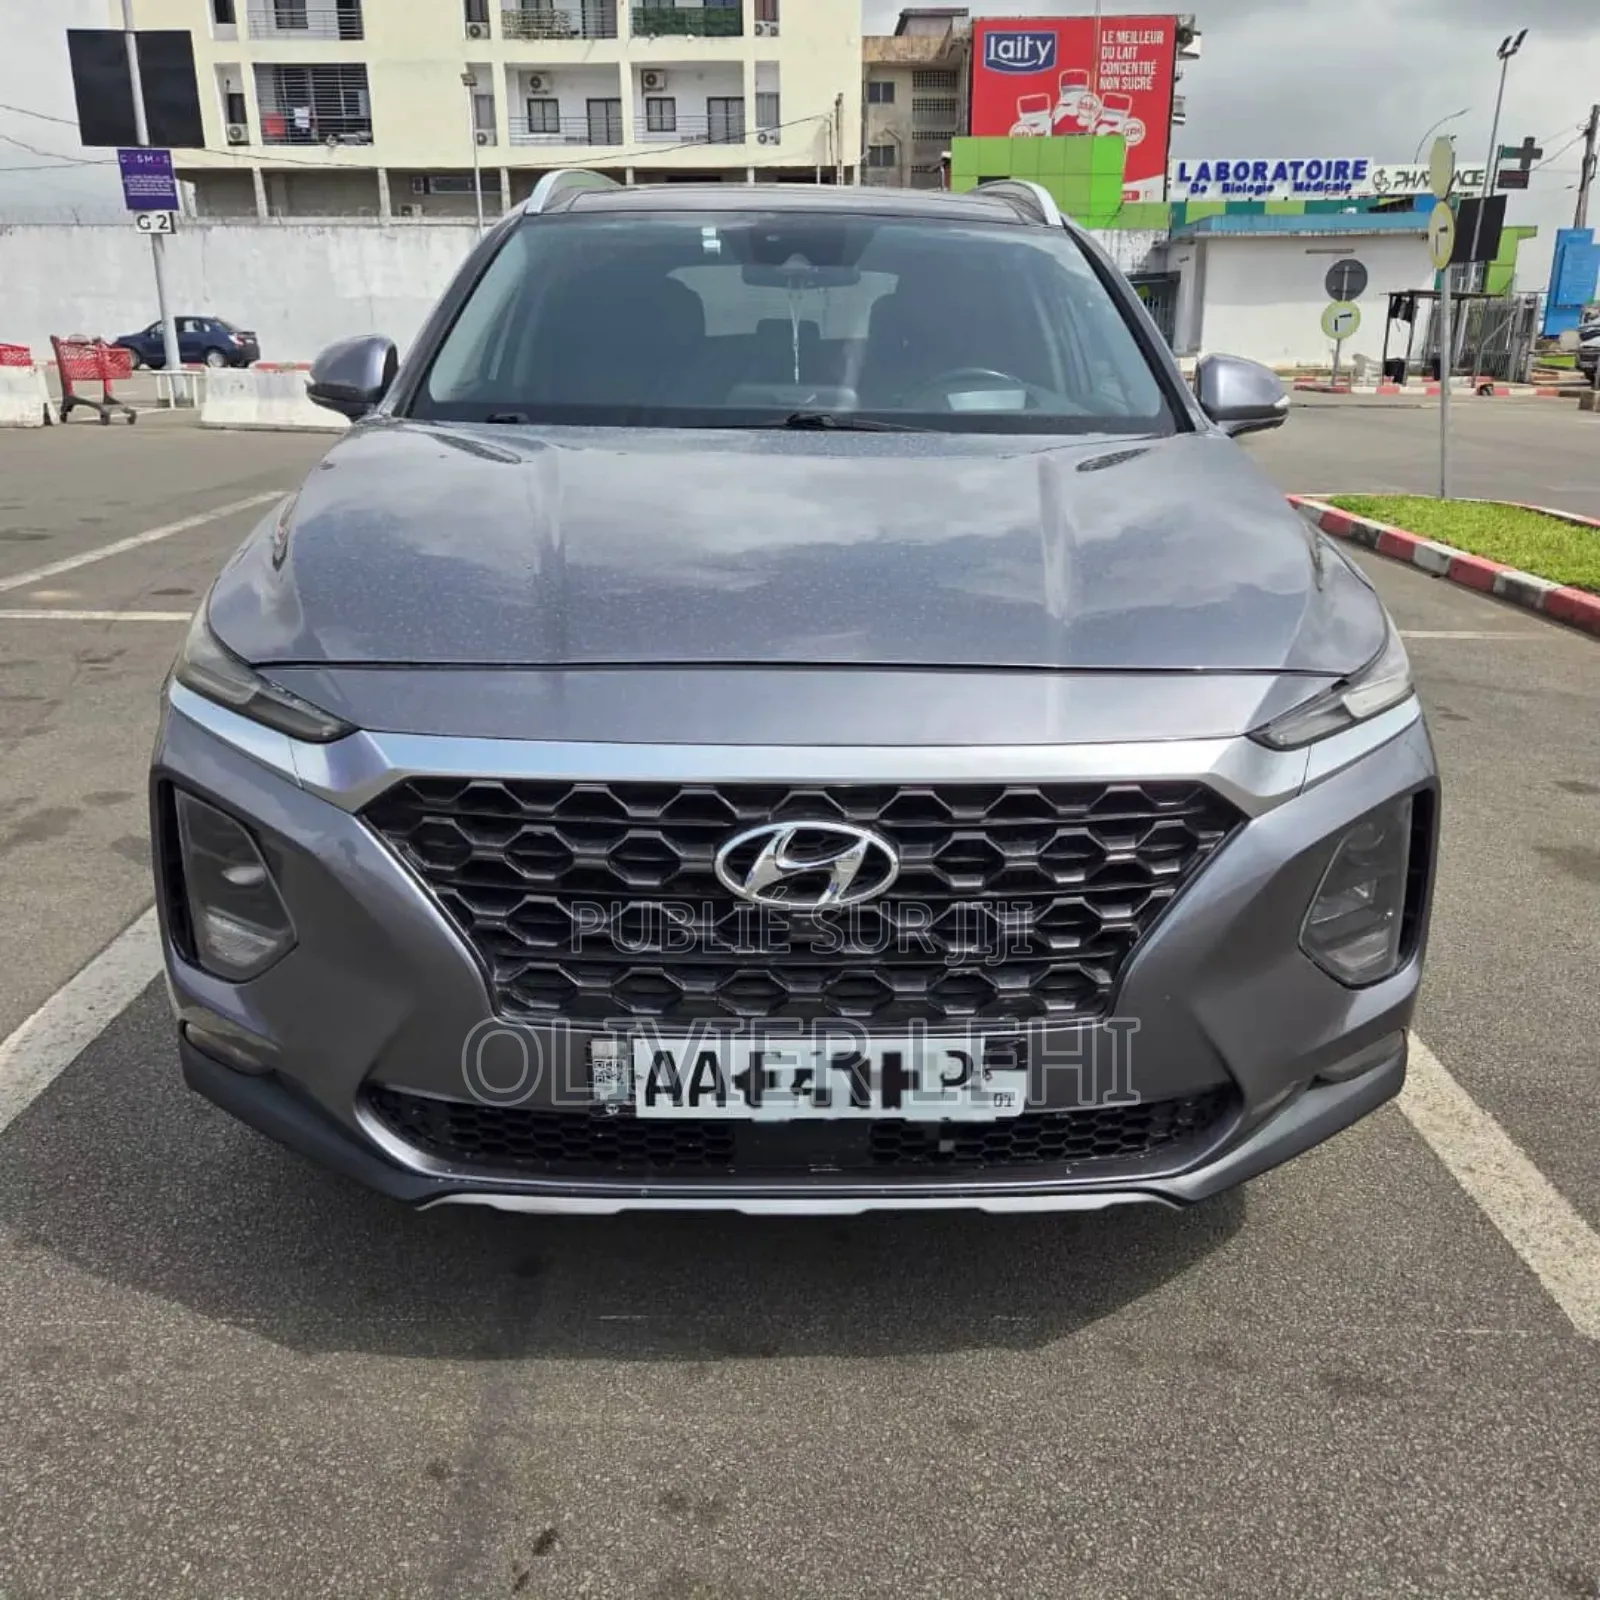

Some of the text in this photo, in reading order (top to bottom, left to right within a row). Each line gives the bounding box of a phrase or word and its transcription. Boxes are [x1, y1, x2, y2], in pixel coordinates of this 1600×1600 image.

[1102, 30, 1164, 44] LE MEILLEUR
[1101, 46, 1139, 60] DU LAIT
[1099, 75, 1120, 90] NON
[1178, 160, 1369, 182] LABORATOIRE
[1189, 182, 1208, 195] De
[1221, 181, 1275, 196] Biologie
